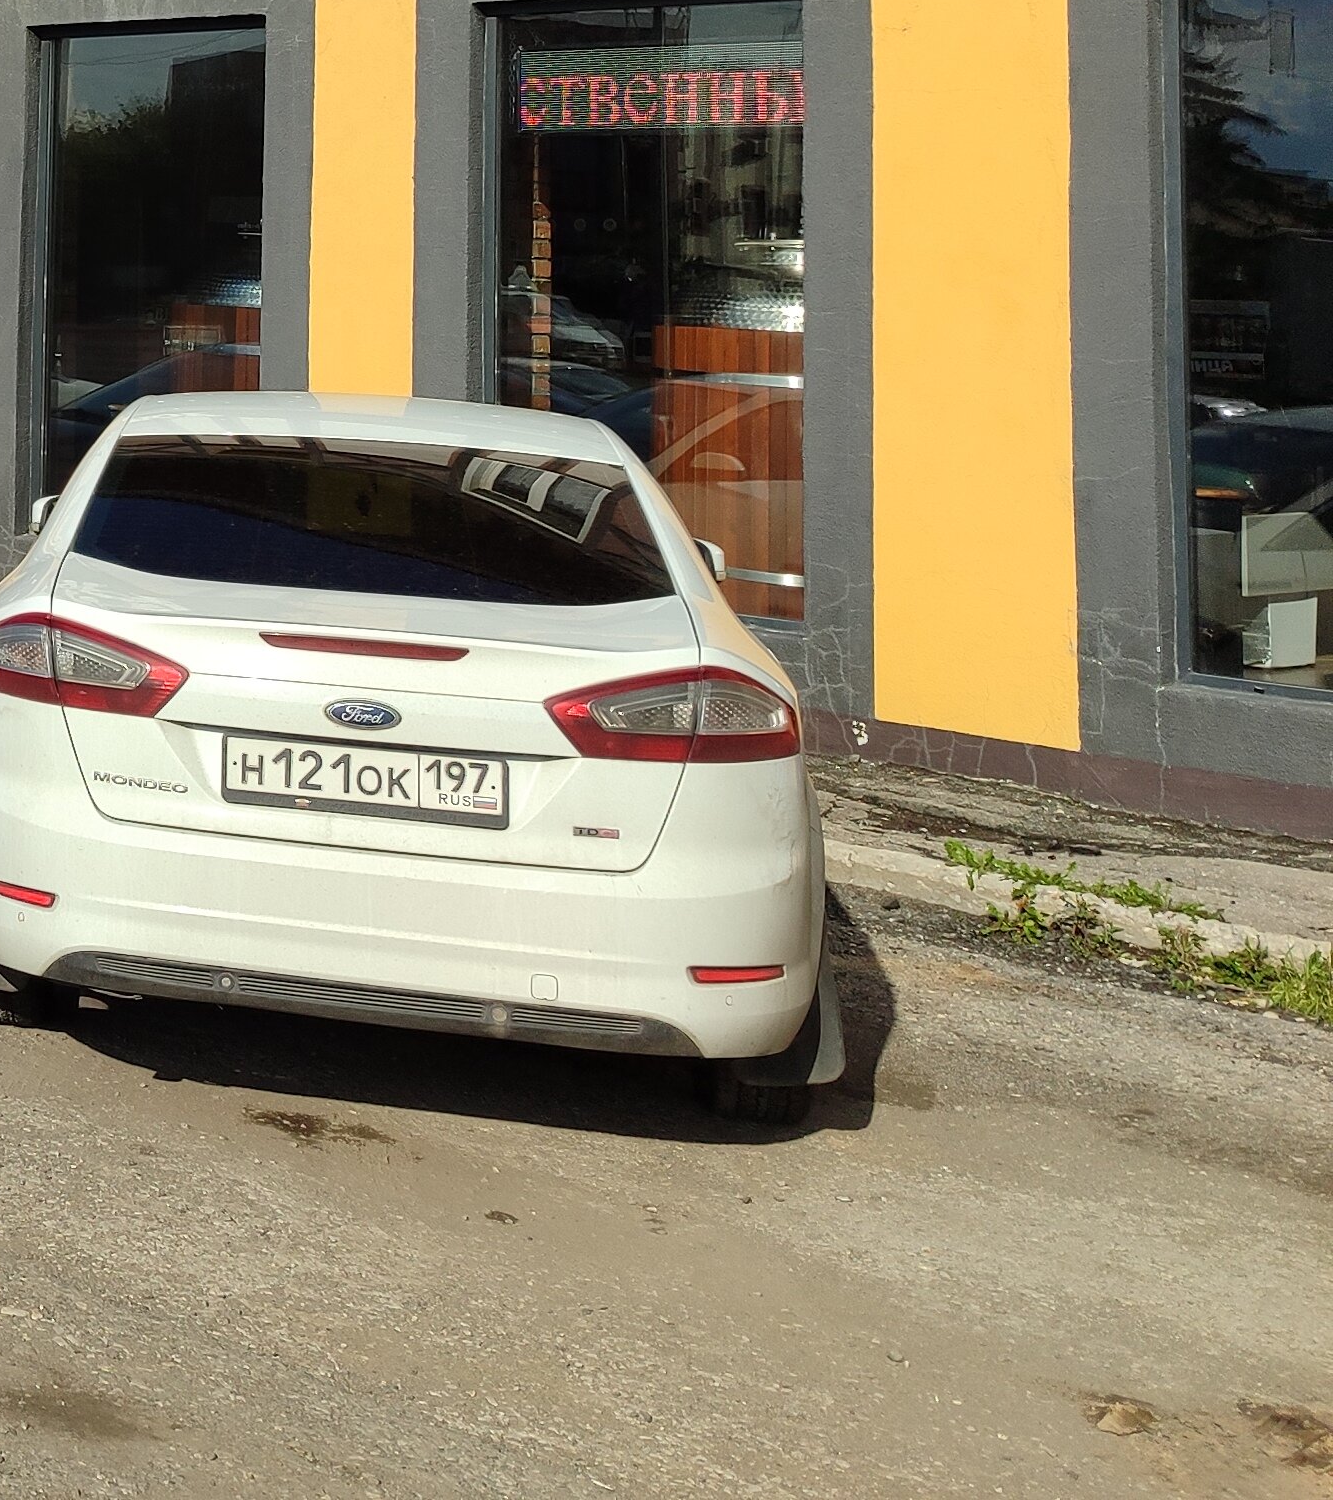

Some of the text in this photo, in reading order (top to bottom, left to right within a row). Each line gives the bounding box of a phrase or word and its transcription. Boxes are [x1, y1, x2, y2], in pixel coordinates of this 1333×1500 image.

[341, 705, 384, 725] Ford
[93, 771, 189, 793] MONDEO
[241, 747, 489, 800] Н121ОК 197
[438, 793, 472, 807] RUS
